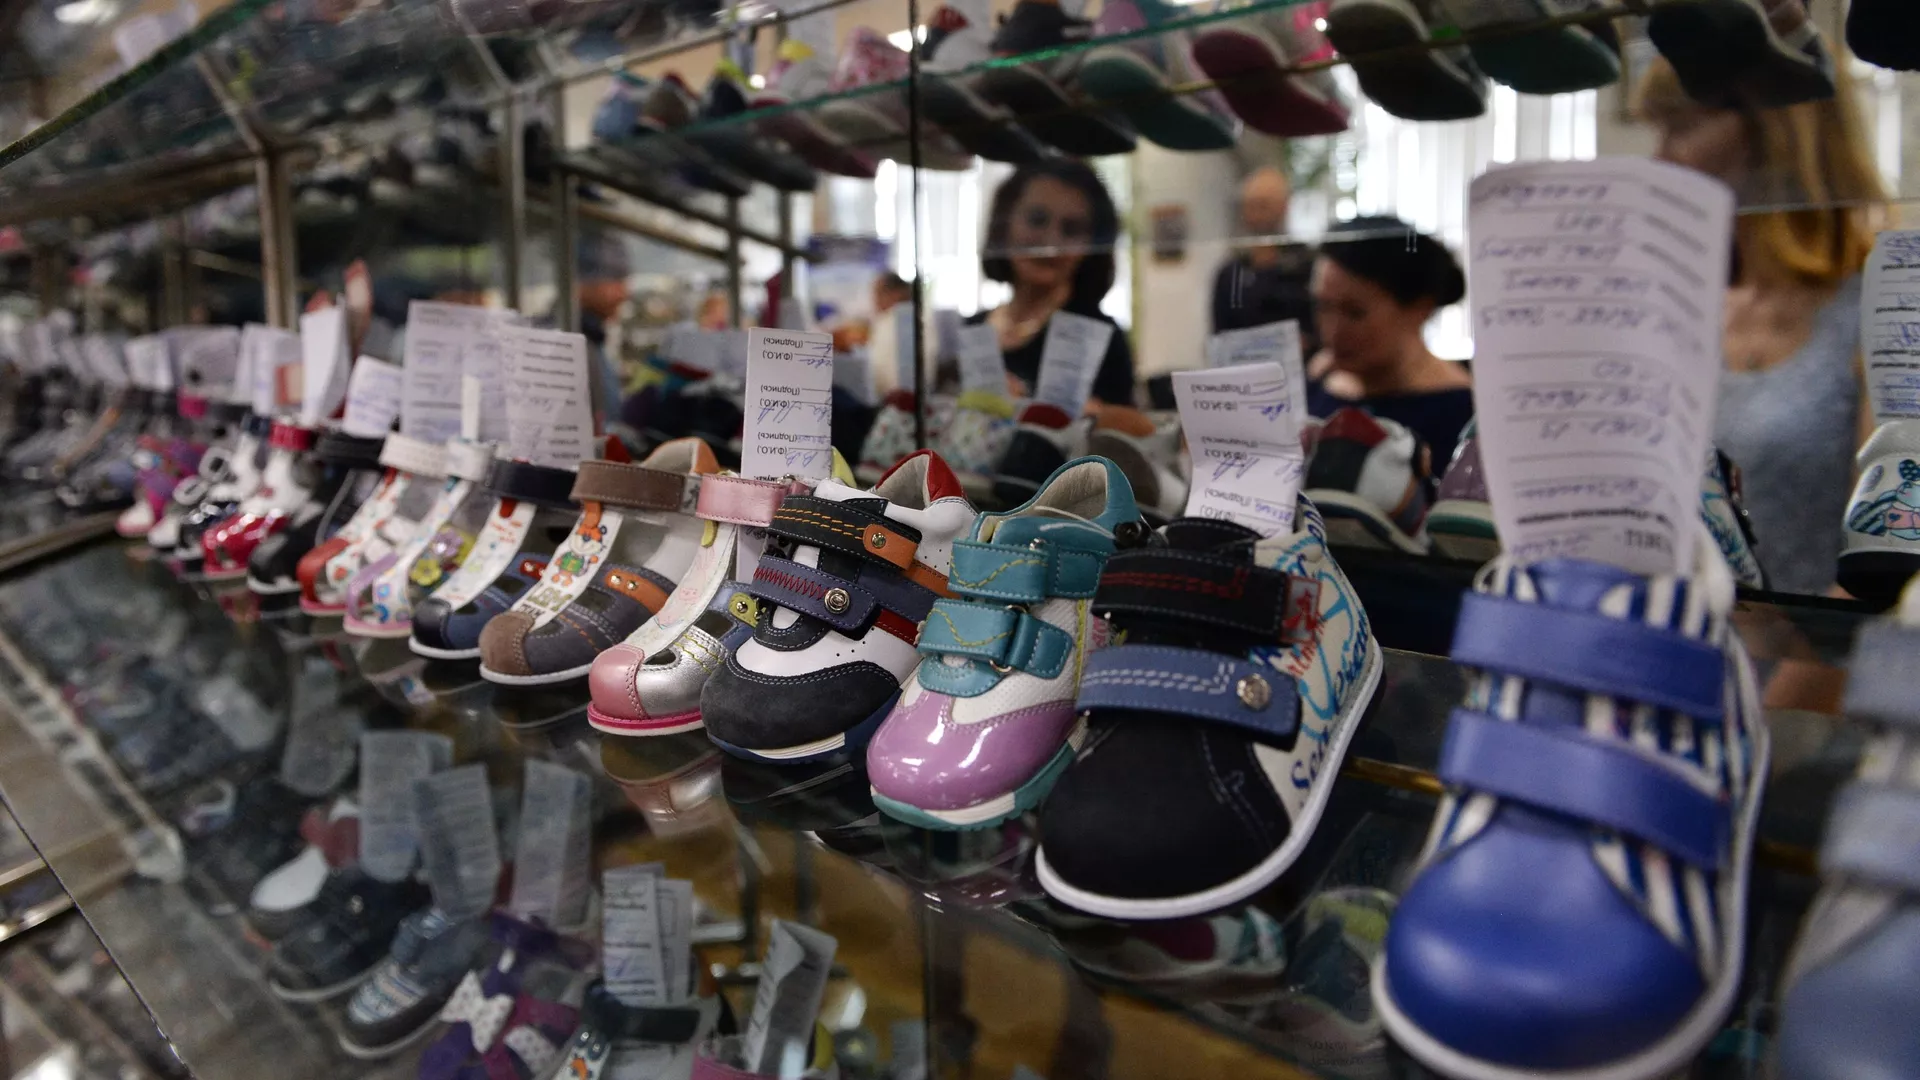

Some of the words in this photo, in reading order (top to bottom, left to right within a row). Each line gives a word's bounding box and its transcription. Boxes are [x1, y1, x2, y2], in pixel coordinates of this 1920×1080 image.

[763, 337, 804, 348] (Подпись)
[762, 350, 793, 361] (Ф.И.О.)
[760, 384, 800, 396] (Подпись)
[759, 398, 790, 409] (Ф.И.О.)
[757, 431, 798, 443] (Подпись)
[757, 445, 787, 455] (Ф.И.О.)
[1204, 488, 1252, 508] (Подпись)
